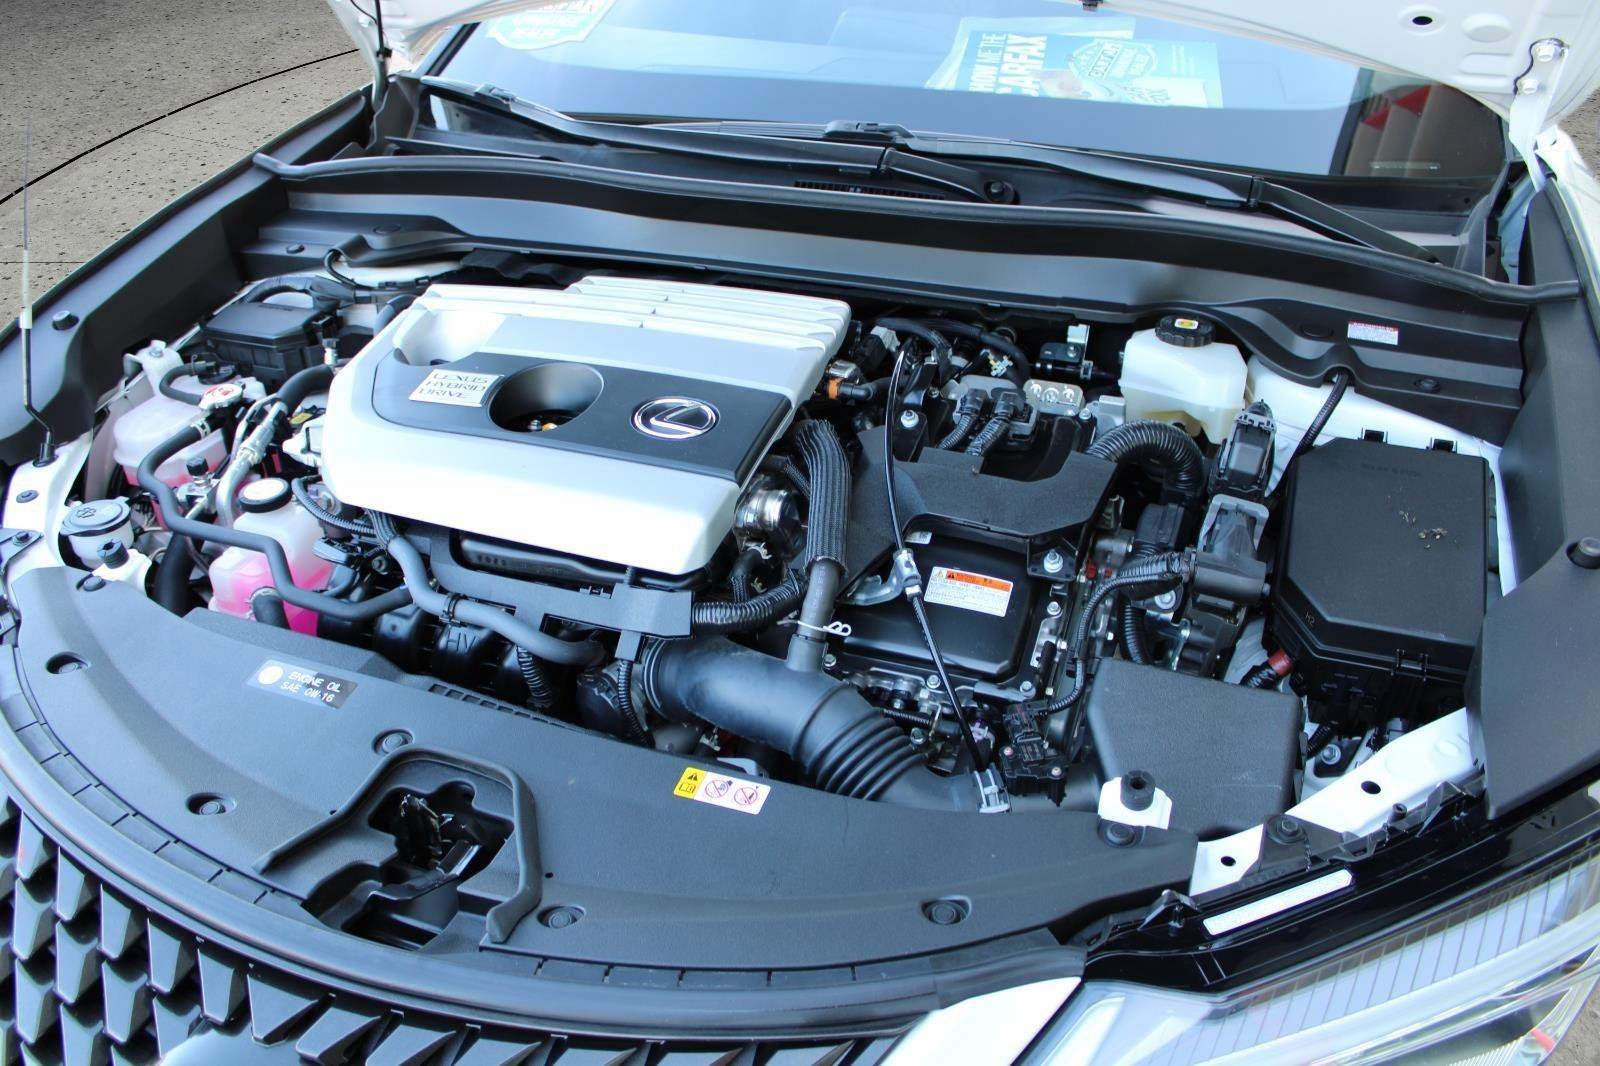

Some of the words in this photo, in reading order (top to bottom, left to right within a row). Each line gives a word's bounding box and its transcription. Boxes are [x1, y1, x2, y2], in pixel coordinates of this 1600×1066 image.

[969, 63, 998, 92] HOW
[425, 381, 486, 392] HYBRID
[433, 373, 488, 384] LEXUS
[419, 388, 470, 399] DRIVE
[288, 671, 325, 687] ENGINE
[326, 681, 341, 693] OIL
[280, 681, 302, 693] SAE
[304, 687, 336, 703] 0W-16
